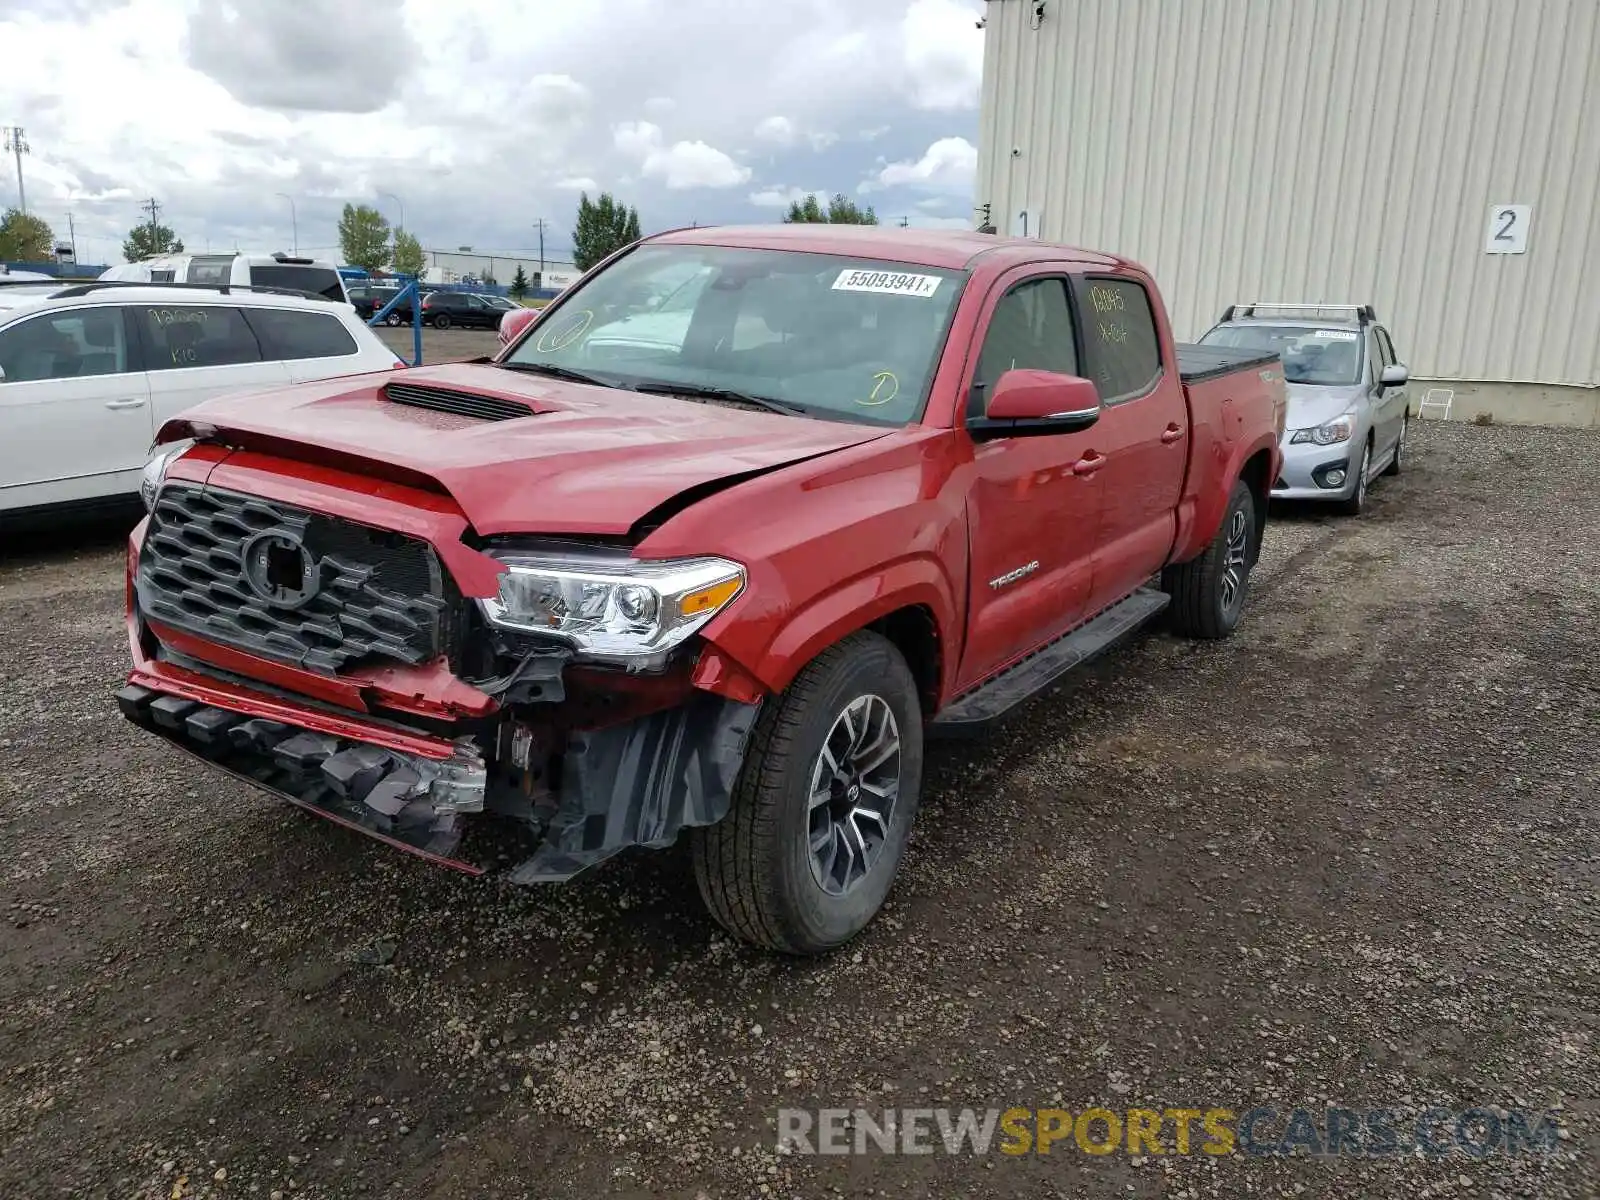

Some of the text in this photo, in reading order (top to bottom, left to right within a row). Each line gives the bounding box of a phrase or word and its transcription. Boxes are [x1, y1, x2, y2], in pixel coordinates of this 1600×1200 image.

[1019, 210, 1028, 238] 1
[1494, 209, 1516, 241] 2
[989, 559, 1040, 589] TACOMA
